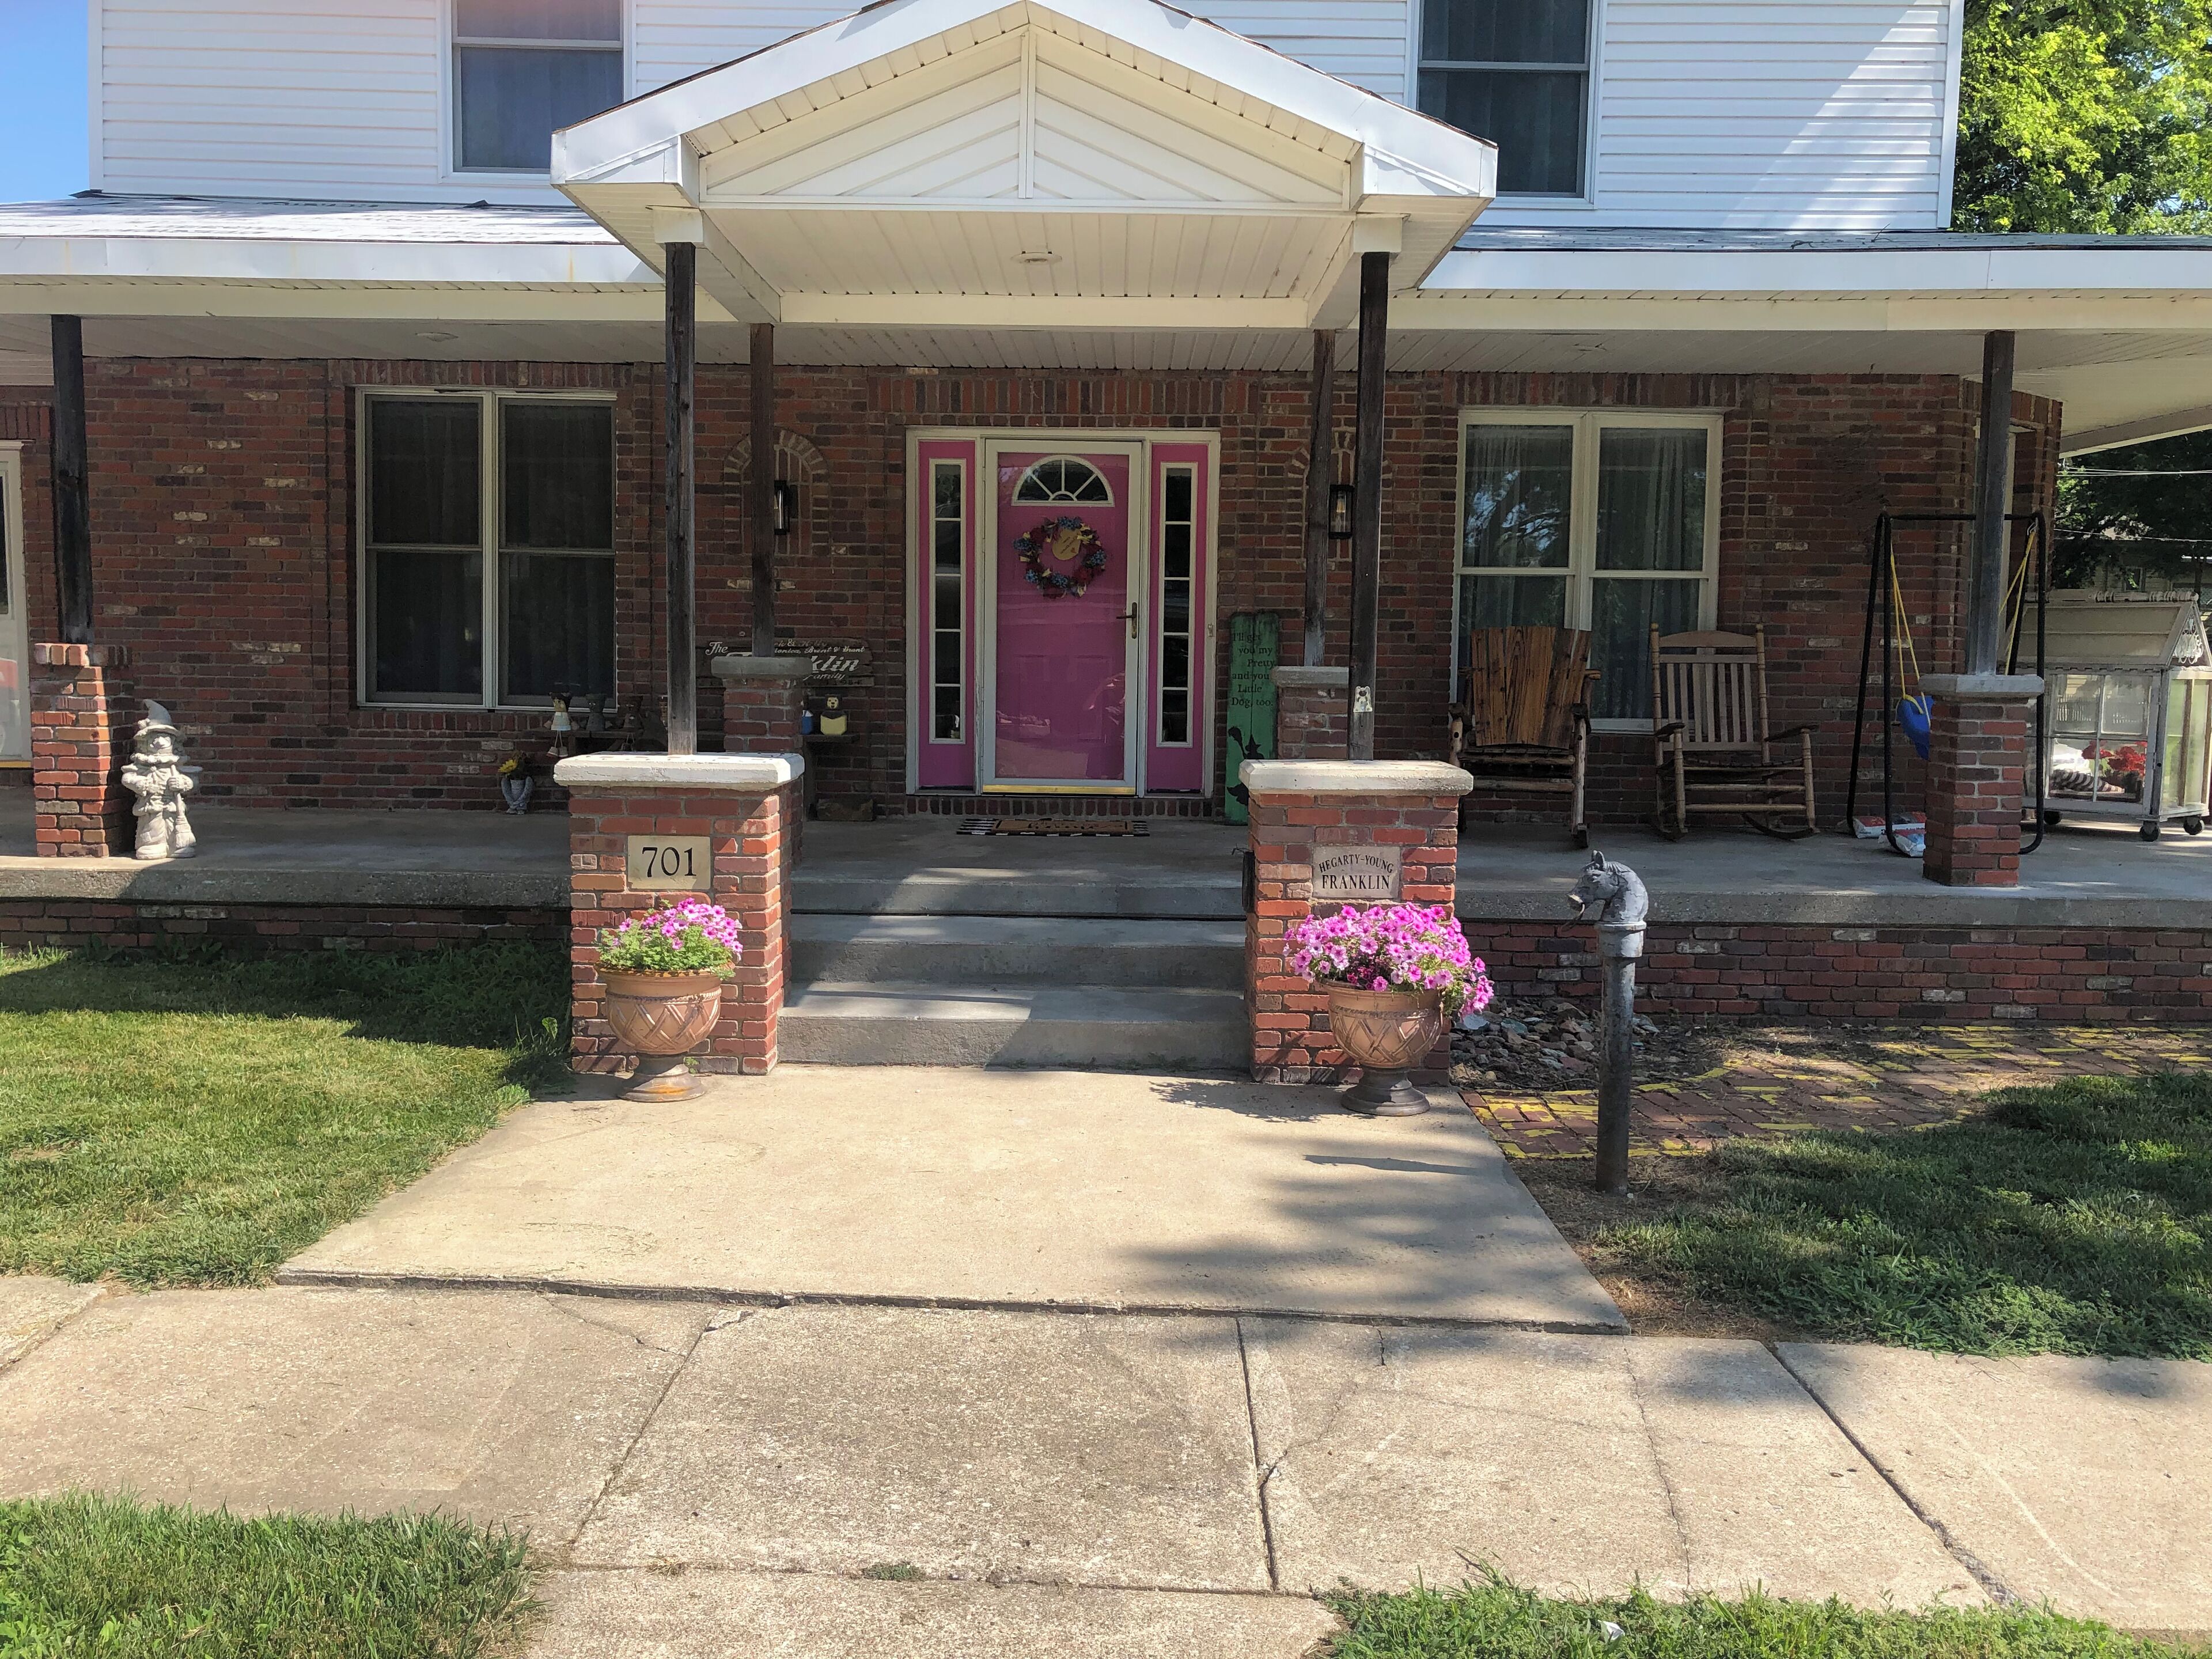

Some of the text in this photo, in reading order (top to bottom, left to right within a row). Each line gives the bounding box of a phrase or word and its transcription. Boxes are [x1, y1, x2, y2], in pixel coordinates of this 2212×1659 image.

[1233, 632, 1244, 641] I'll
[705, 641, 728, 656] The
[1239, 647, 1272, 657] you my
[1232, 671, 1249, 680] and
[1238, 684, 1262, 693] Little
[1232, 697, 1253, 709] Dog,
[642, 847, 696, 877] 701
[1319, 854, 1393, 873] HEGARTY-YOUNG
[1322, 875, 1389, 889] FRANKLIN
